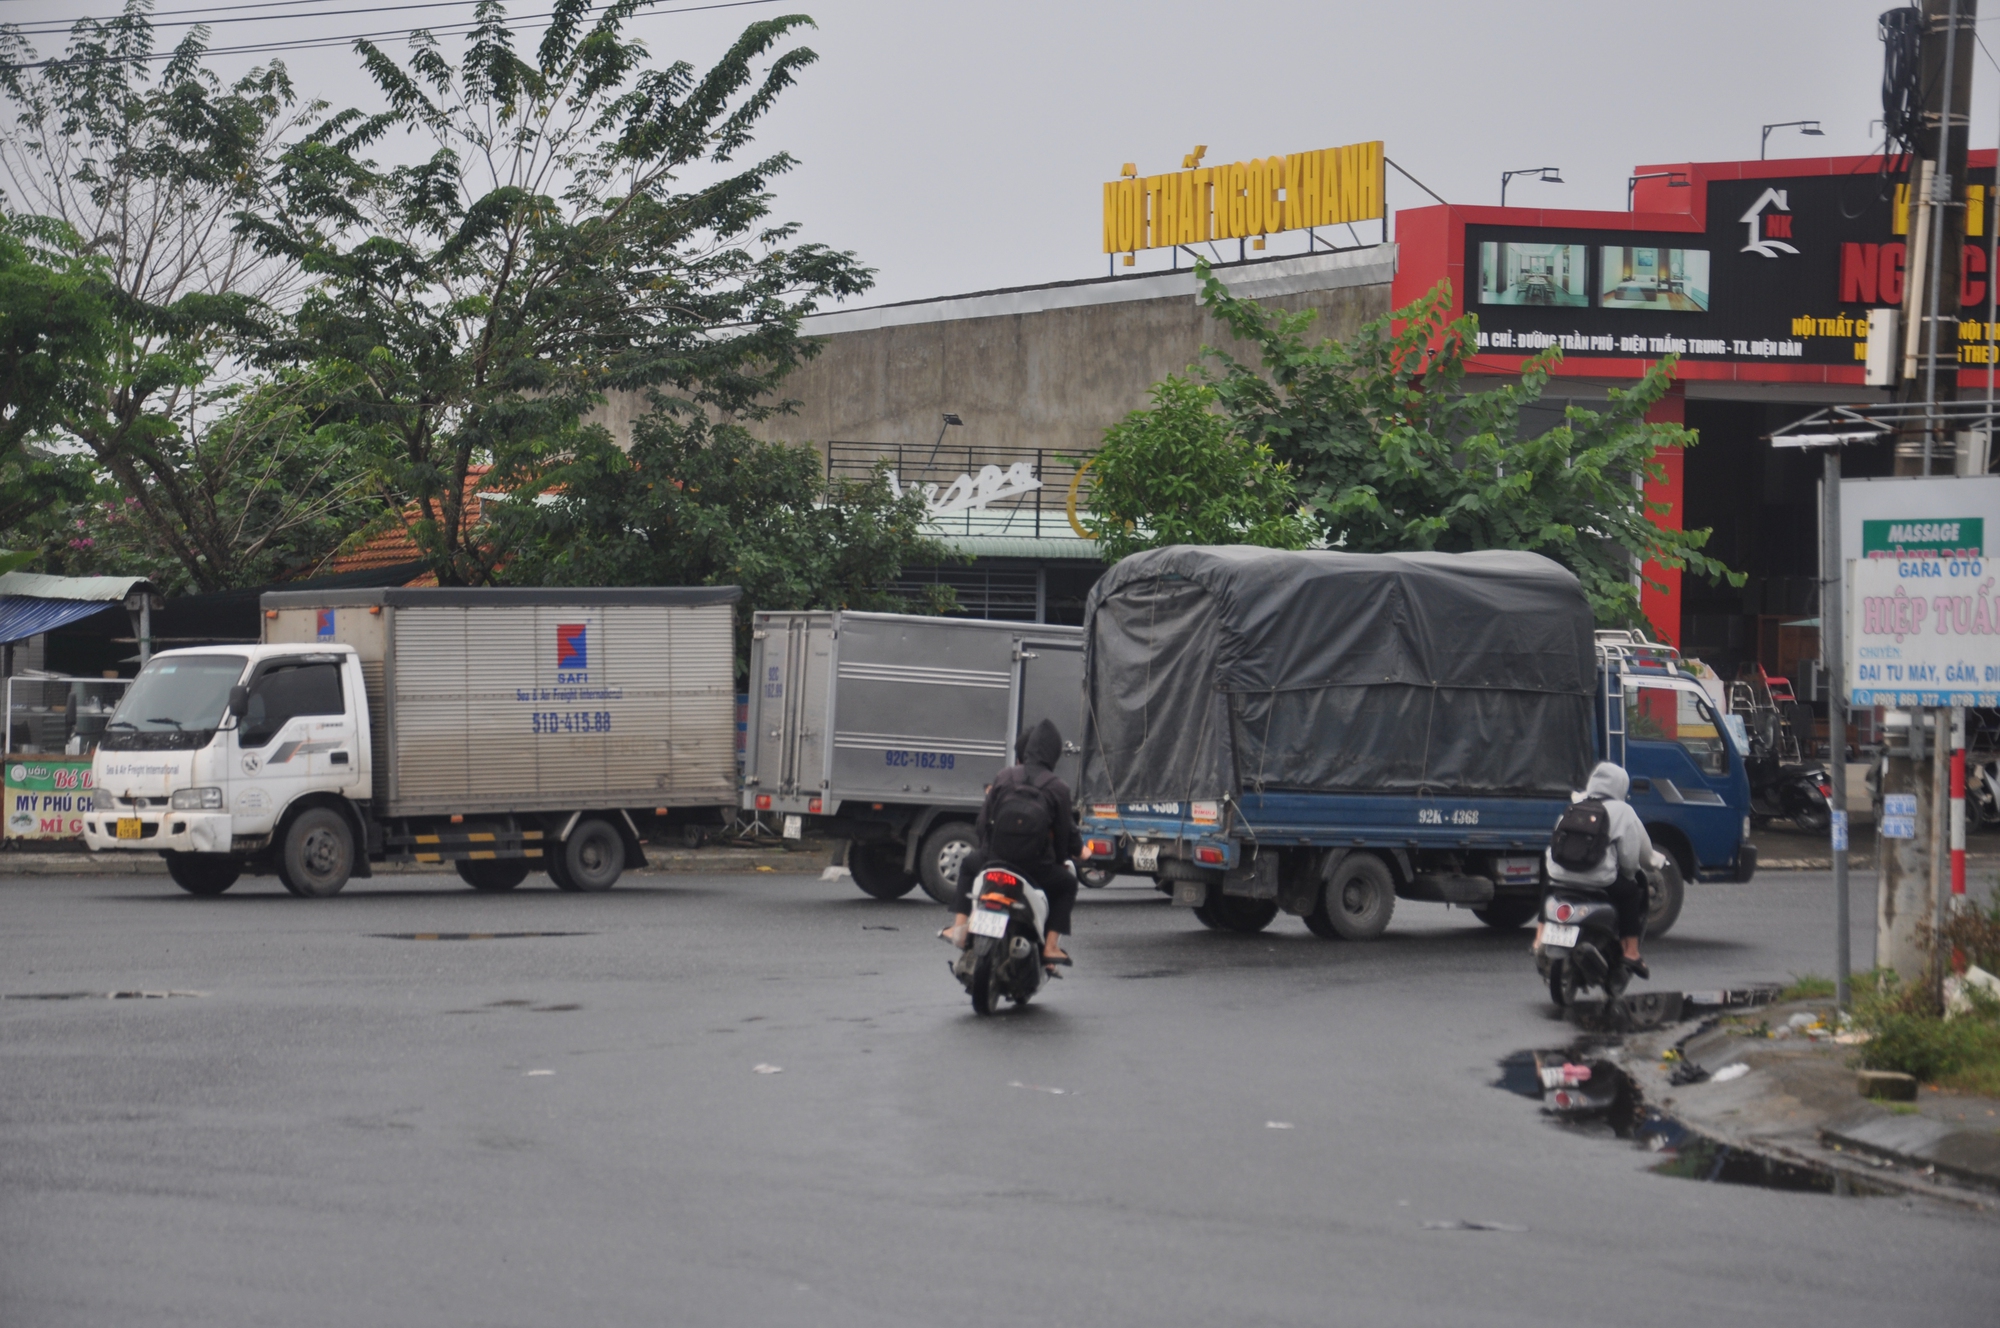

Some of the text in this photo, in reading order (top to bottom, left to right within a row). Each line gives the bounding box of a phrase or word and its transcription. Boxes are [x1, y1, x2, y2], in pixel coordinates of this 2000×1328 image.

[1103, 140, 1384, 266] NỘI THẤT NGỌC KHANH
[1766, 214, 1793, 238] NK
[1840, 242, 1986, 307] NGC
[1792, 314, 1816, 339] NỘI
[1818, 311, 1854, 337] THẤT
[1475, 332, 1489, 349] ỊA
[1518, 330, 1557, 349] ĐƯỜNG
[1559, 329, 1589, 350] TRẦN
[1590, 334, 1614, 351] PHÚ
[1621, 334, 1647, 354] ĐIỆN
[1688, 338, 1726, 354] TRUNG
[1778, 338, 1802, 356] BÀN
[1888, 523, 1961, 542] MASSAGE
[1898, 562, 1942, 578] GARA
[1863, 585, 1928, 644] HIỆP
[557, 673, 588, 684] SAFI
[886, 750, 955, 770] 92C-162.99
[53, 768, 78, 789] Bé
[43, 792, 72, 812] PHÚ
